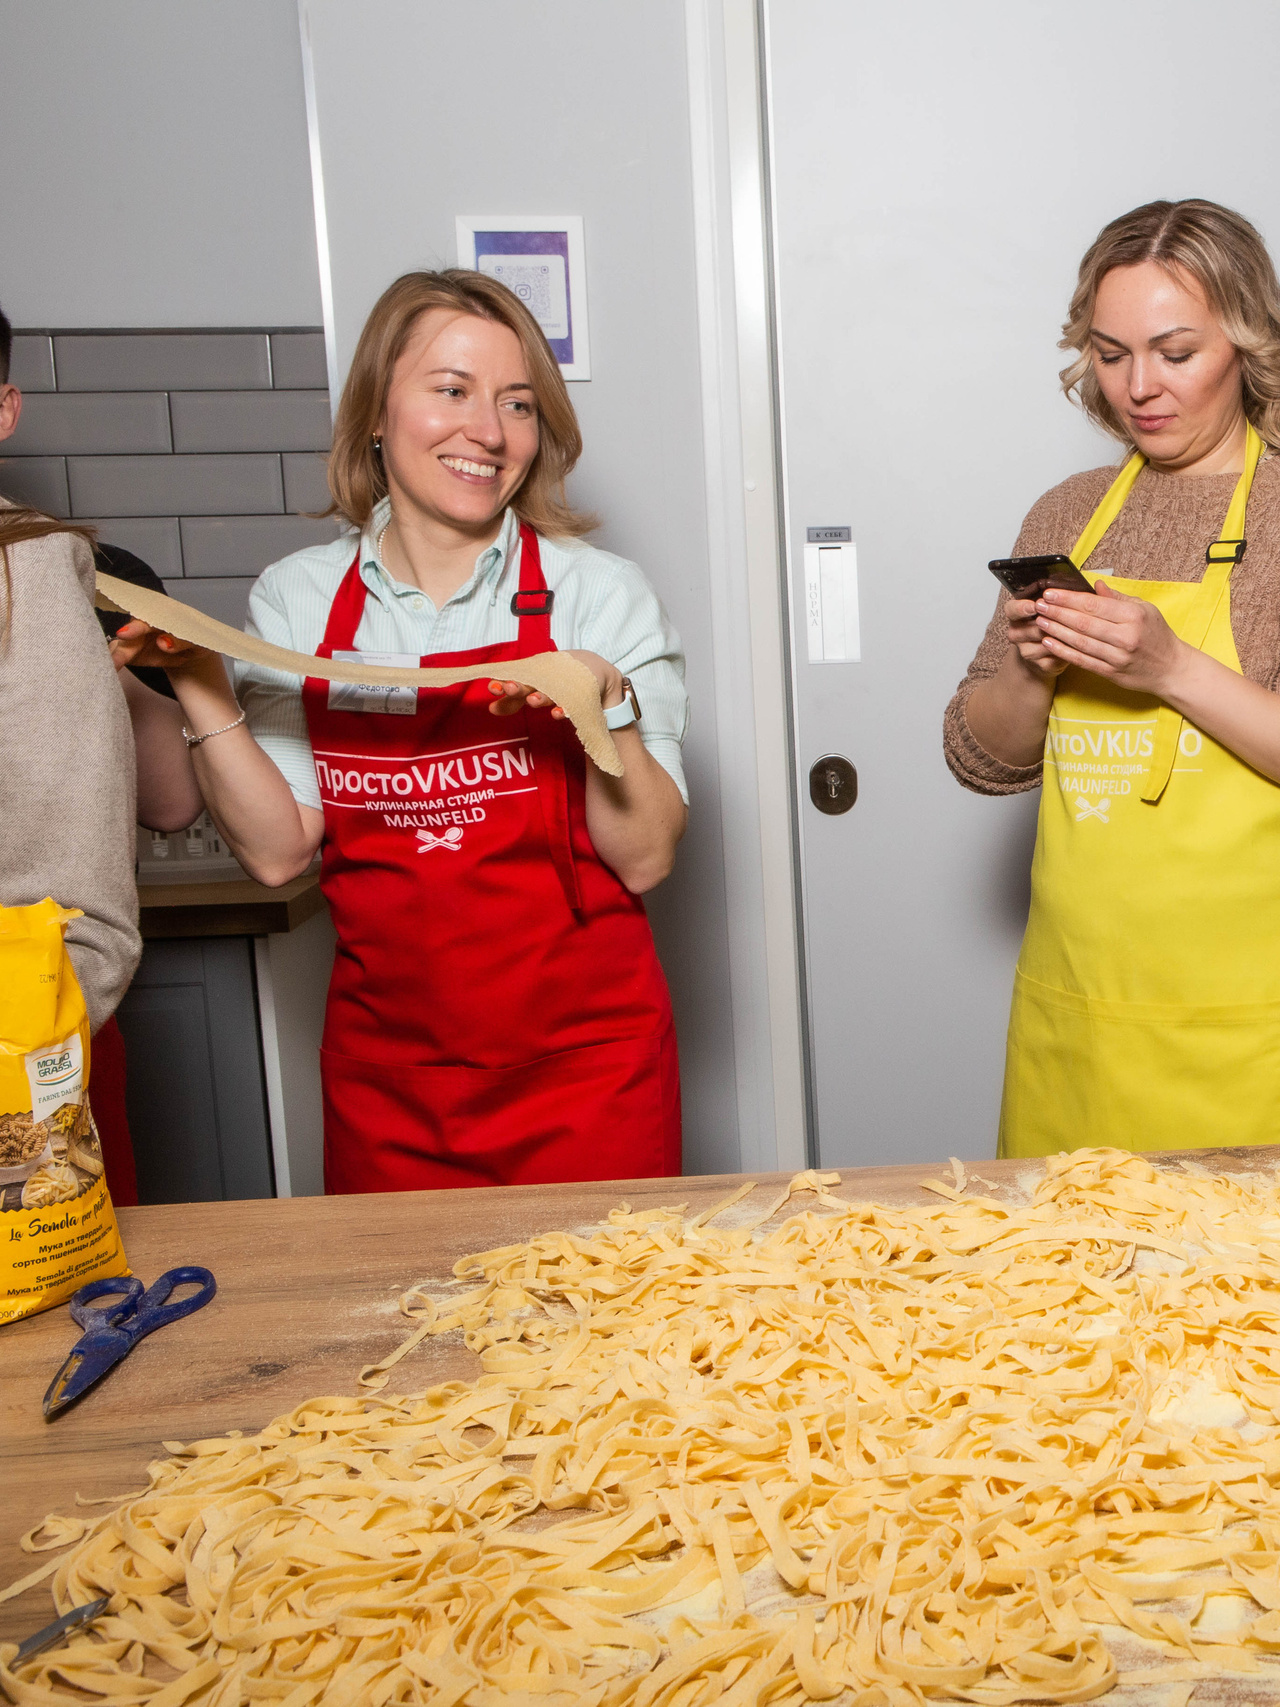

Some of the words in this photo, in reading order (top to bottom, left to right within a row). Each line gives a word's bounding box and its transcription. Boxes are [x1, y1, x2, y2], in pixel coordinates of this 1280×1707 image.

[316, 747, 535, 797] ПростоVKUSN
[365, 798, 445, 811] КУЛИНАРНАЯ
[446, 789, 496, 808] СТУДИЯ
[384, 807, 487, 828] MAUNFELD
[9, 1228, 24, 1242] La
[28, 1212, 79, 1237] Semola
[12, 1256, 48, 1269] сортов
[49, 1242, 89, 1261] пшеницы
[39, 1242, 63, 1254] Мука
[65, 1238, 75, 1246] из
[36, 1269, 65, 1284] Semola
[66, 1264, 74, 1273] di
[74, 1257, 94, 1273] grano
[7, 1287, 31, 1296] Мука
[33, 1284, 43, 1292] из
